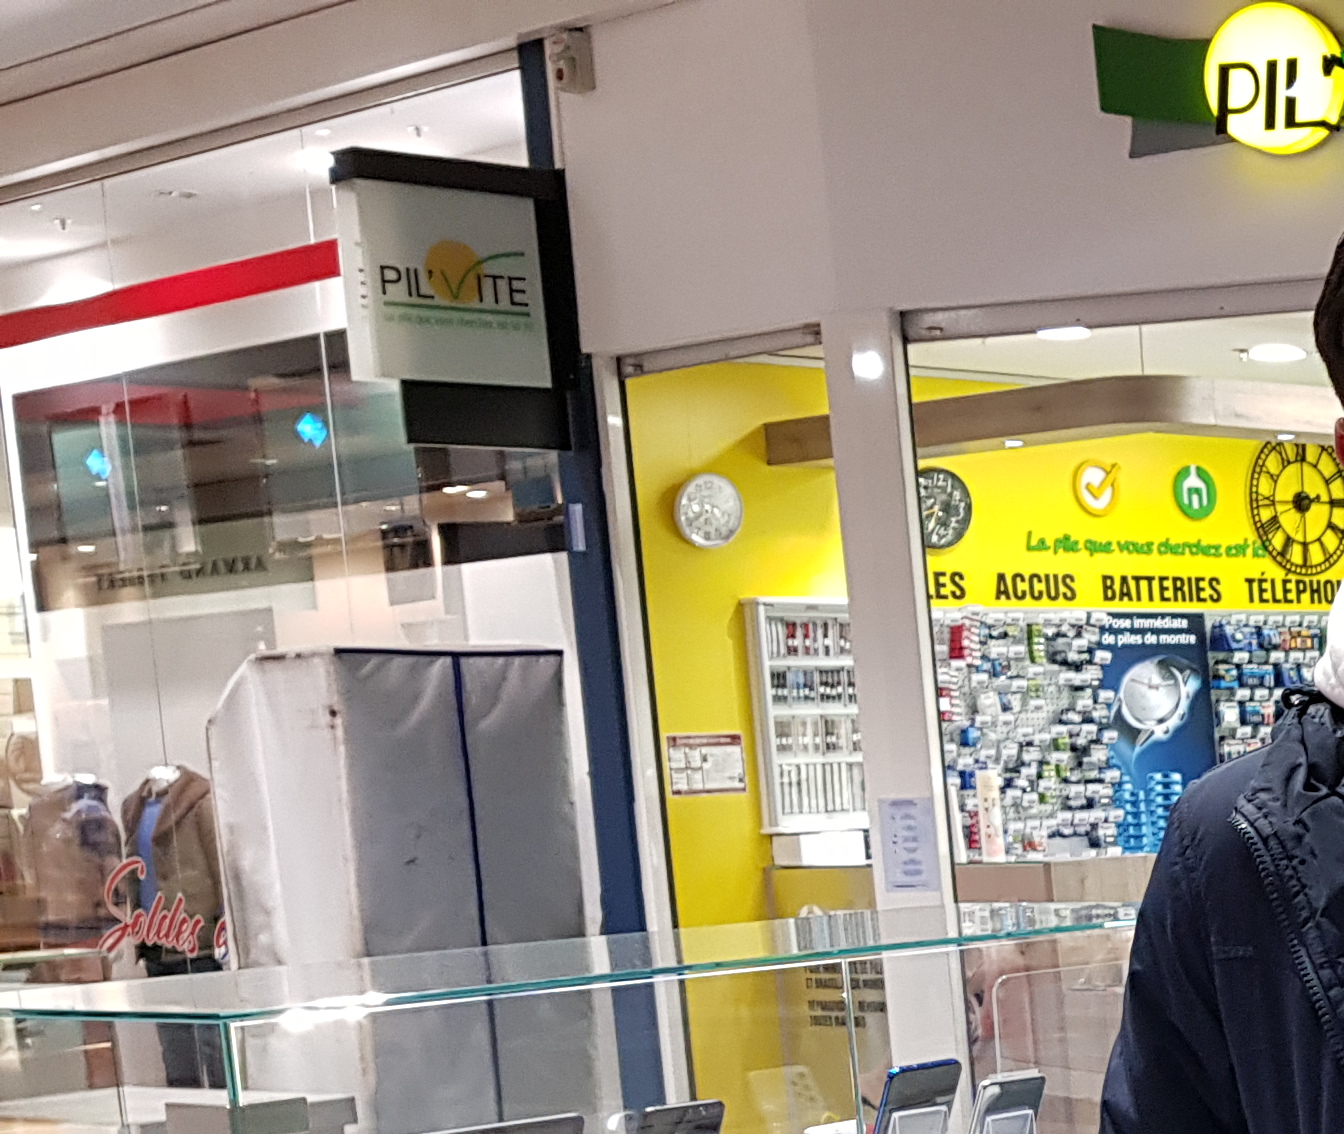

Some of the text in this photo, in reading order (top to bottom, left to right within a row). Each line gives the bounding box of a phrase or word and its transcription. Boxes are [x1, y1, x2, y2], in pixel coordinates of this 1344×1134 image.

[379, 252, 529, 308] PIL'VITE
[1025, 529, 1051, 552] La
[1053, 533, 1082, 555] pile
[1084, 538, 1115, 557] que
[1116, 540, 1155, 556] vous
[1157, 537, 1223, 558] cherchez
[1225, 537, 1250, 558] est
[994, 572, 1077, 602] ACCUS
[1102, 574, 1221, 604] BATTERIES
[1244, 571, 1342, 605] TÉLÉPHO
[1105, 615, 1189, 629] Pose immédiate
[1101, 631, 1197, 648] de piles de montre
[98, 856, 204, 957] Soldes
